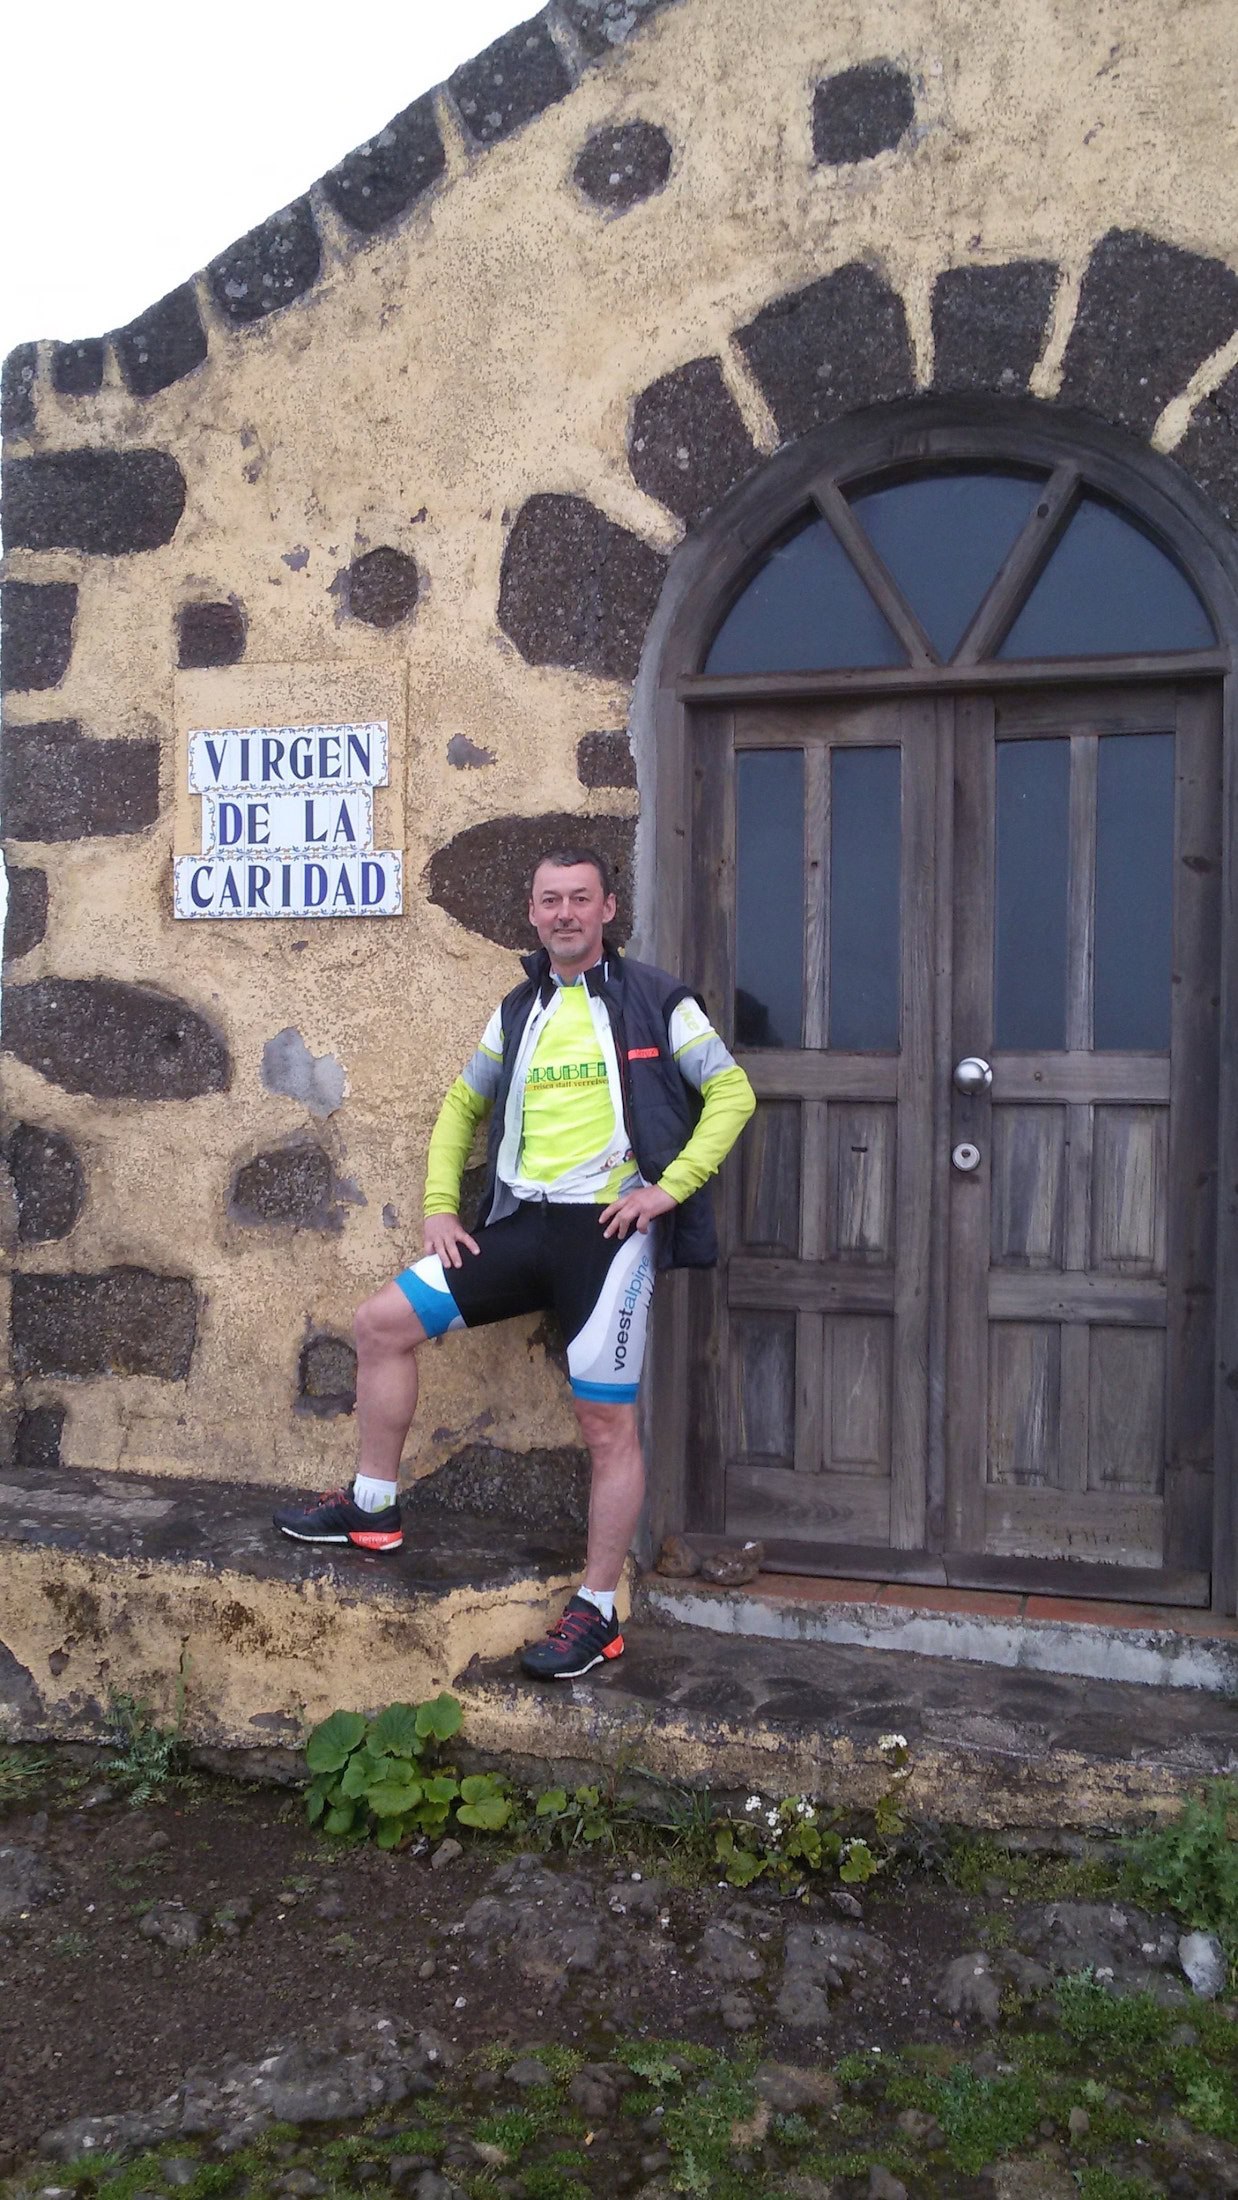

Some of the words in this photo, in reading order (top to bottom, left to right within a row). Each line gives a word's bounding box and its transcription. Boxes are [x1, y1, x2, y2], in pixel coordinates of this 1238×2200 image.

[204, 733, 371, 782] VIRGEN
[218, 802, 271, 846] DE
[304, 798, 357, 843] LA
[190, 861, 386, 908] CARIDAD
[614, 1255, 650, 1371] voestalpine
